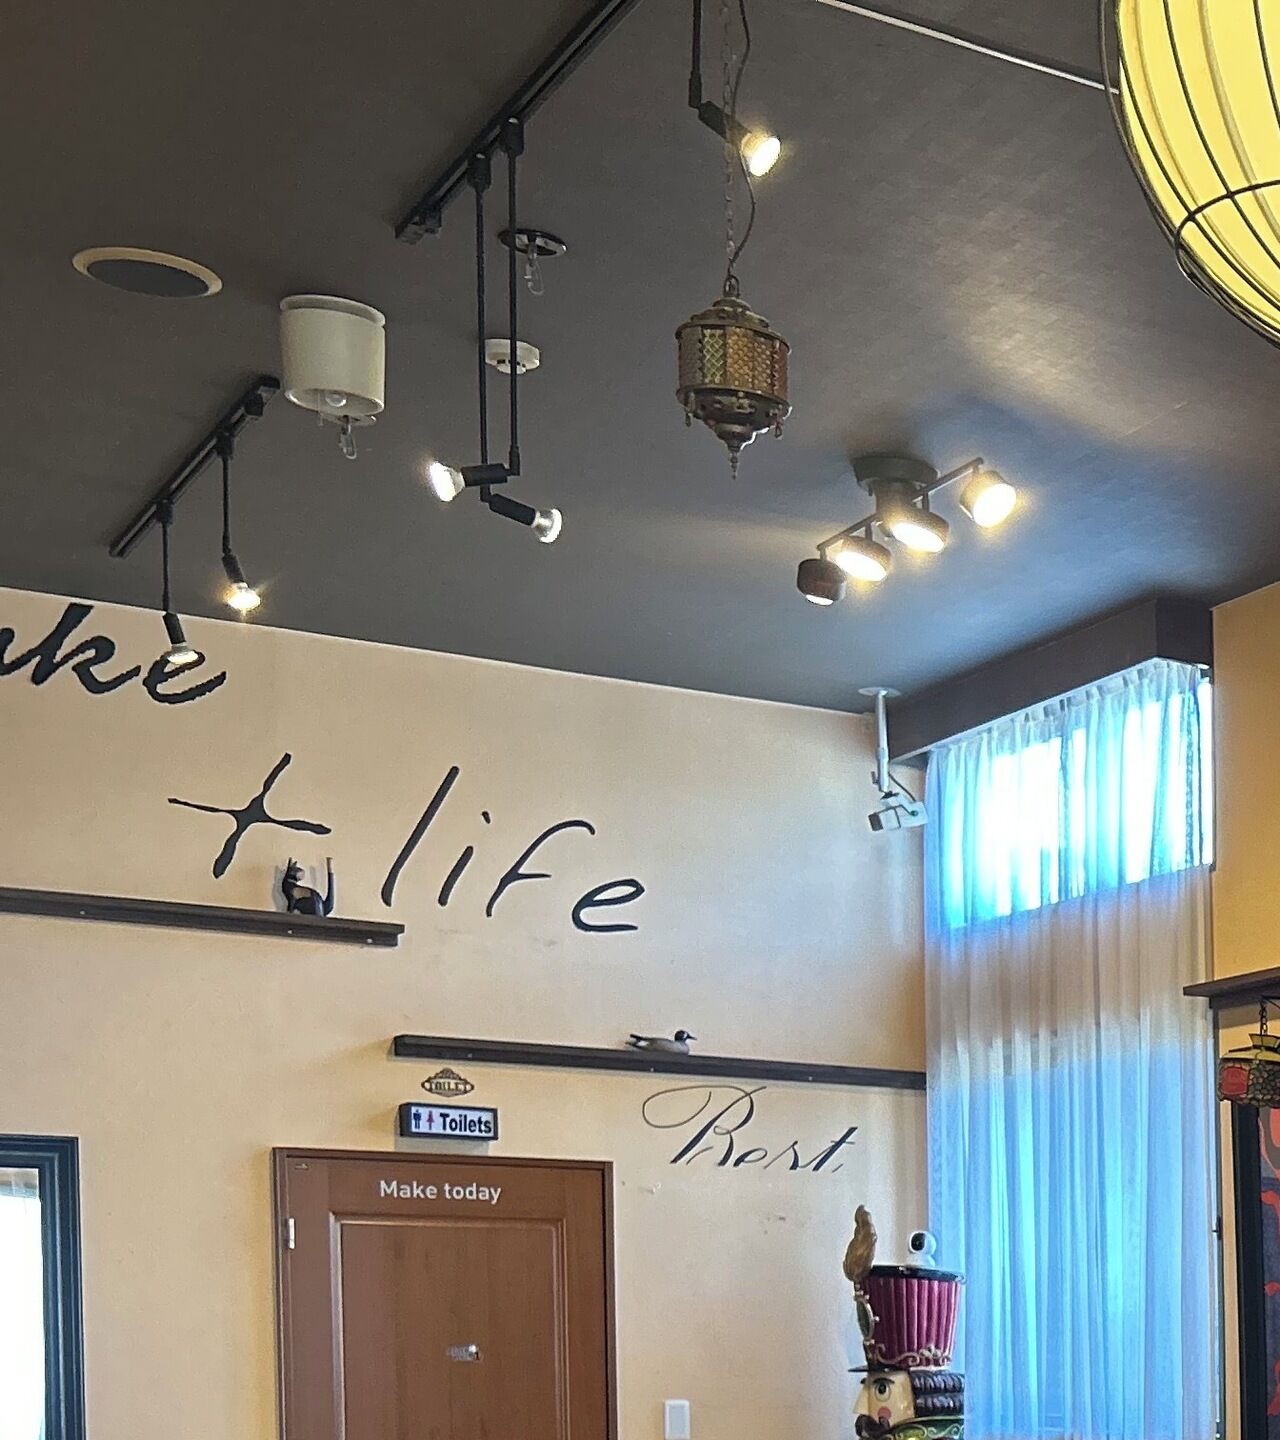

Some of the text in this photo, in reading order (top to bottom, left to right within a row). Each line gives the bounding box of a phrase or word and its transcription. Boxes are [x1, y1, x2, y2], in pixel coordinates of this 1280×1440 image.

[380, 766, 645, 932] life
[439, 1112, 492, 1134] Toilets
[380, 1180, 502, 1205] Make today
